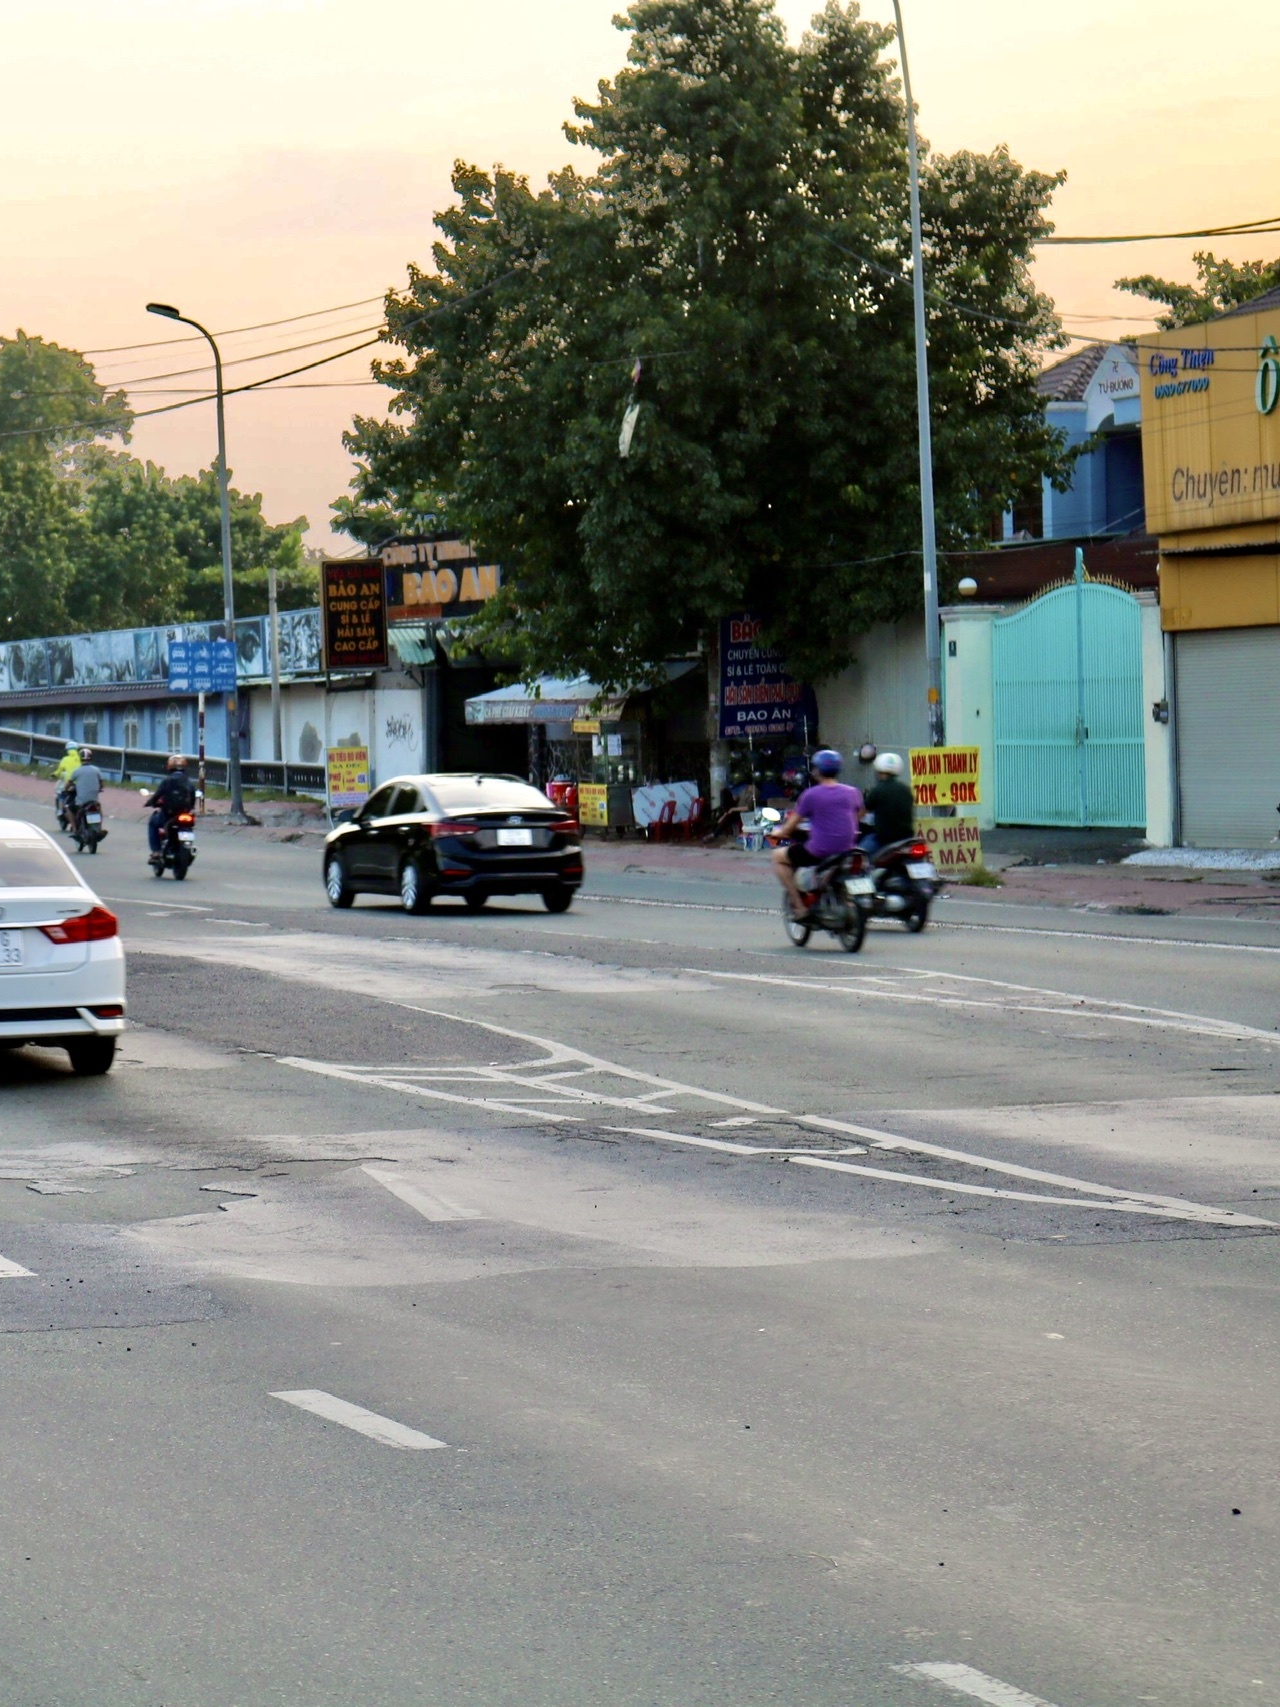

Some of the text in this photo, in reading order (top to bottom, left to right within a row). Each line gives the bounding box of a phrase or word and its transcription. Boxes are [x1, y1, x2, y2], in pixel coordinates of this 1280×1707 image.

[328, 580, 380, 597] BẢO AN
[459, 565, 500, 602] AN
[329, 601, 358, 611] CUNG
[334, 642, 356, 651] CAO
[943, 752, 968, 774] THANH
[914, 783, 938, 804] 70K
[950, 782, 977, 803] 90K
[916, 818, 979, 843] ẢO HIỂM
[939, 844, 977, 864] MÁY
